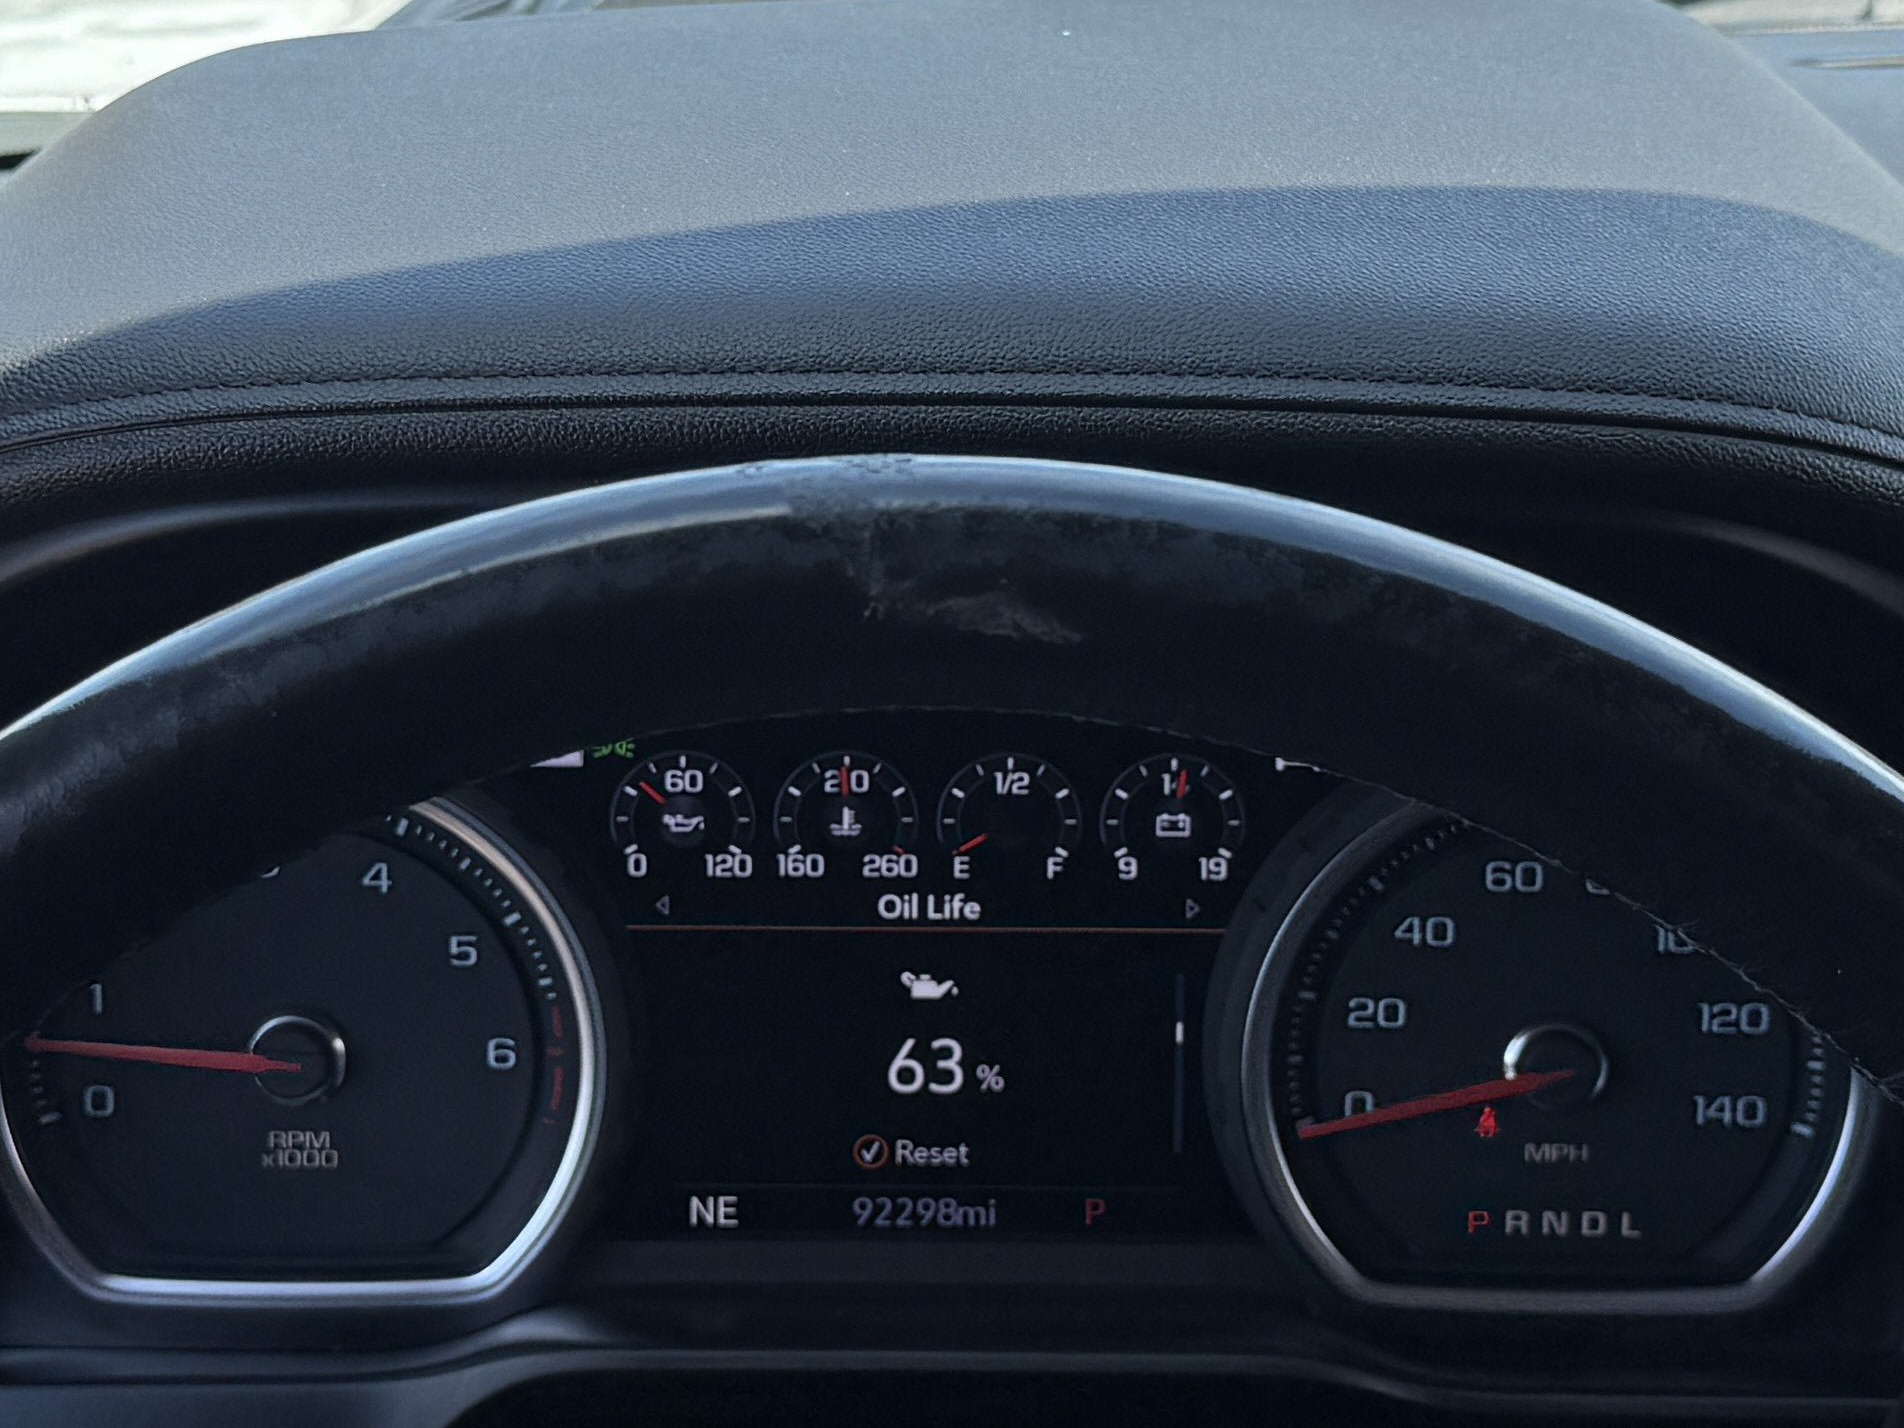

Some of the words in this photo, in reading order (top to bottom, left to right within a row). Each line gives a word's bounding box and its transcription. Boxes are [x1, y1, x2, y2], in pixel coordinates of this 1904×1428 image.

[665, 770, 703, 792] 60
[822, 767, 872, 797] 20
[362, 862, 392, 893] 4
[628, 853, 647, 876] 0
[706, 854, 752, 876] 120
[778, 854, 824, 876] 160
[863, 854, 918, 876] 260
[953, 856, 969, 878] E
[1047, 857, 1063, 879] F
[1118, 856, 1137, 879] 9
[1200, 857, 1227, 879] 19
[1485, 861, 1543, 892] 60
[878, 893, 918, 919] Oil
[927, 893, 981, 920] Life
[1394, 917, 1454, 946] 40
[450, 935, 477, 966] 5
[87, 983, 103, 1013] 1
[1348, 998, 1406, 1027] 20
[1701, 1003, 1769, 1033] 120
[487, 1038, 516, 1068] 6
[888, 1037, 964, 1094] 63
[976, 1064, 1005, 1091] %
[84, 1085, 115, 1116] 0
[1695, 1096, 1765, 1125] 140
[270, 1131, 330, 1148] RPM
[895, 1139, 969, 1164] Reset
[1524, 1143, 1587, 1161] MPH
[690, 1196, 738, 1225] NE
[853, 1197, 996, 1226] 92298mi
[1085, 1198, 1106, 1225] P
[1468, 1211, 1490, 1233] P
[1505, 1210, 1528, 1233] R
[1542, 1211, 1567, 1235] N
[1581, 1211, 1606, 1235] D
[1621, 1212, 1640, 1237] L
